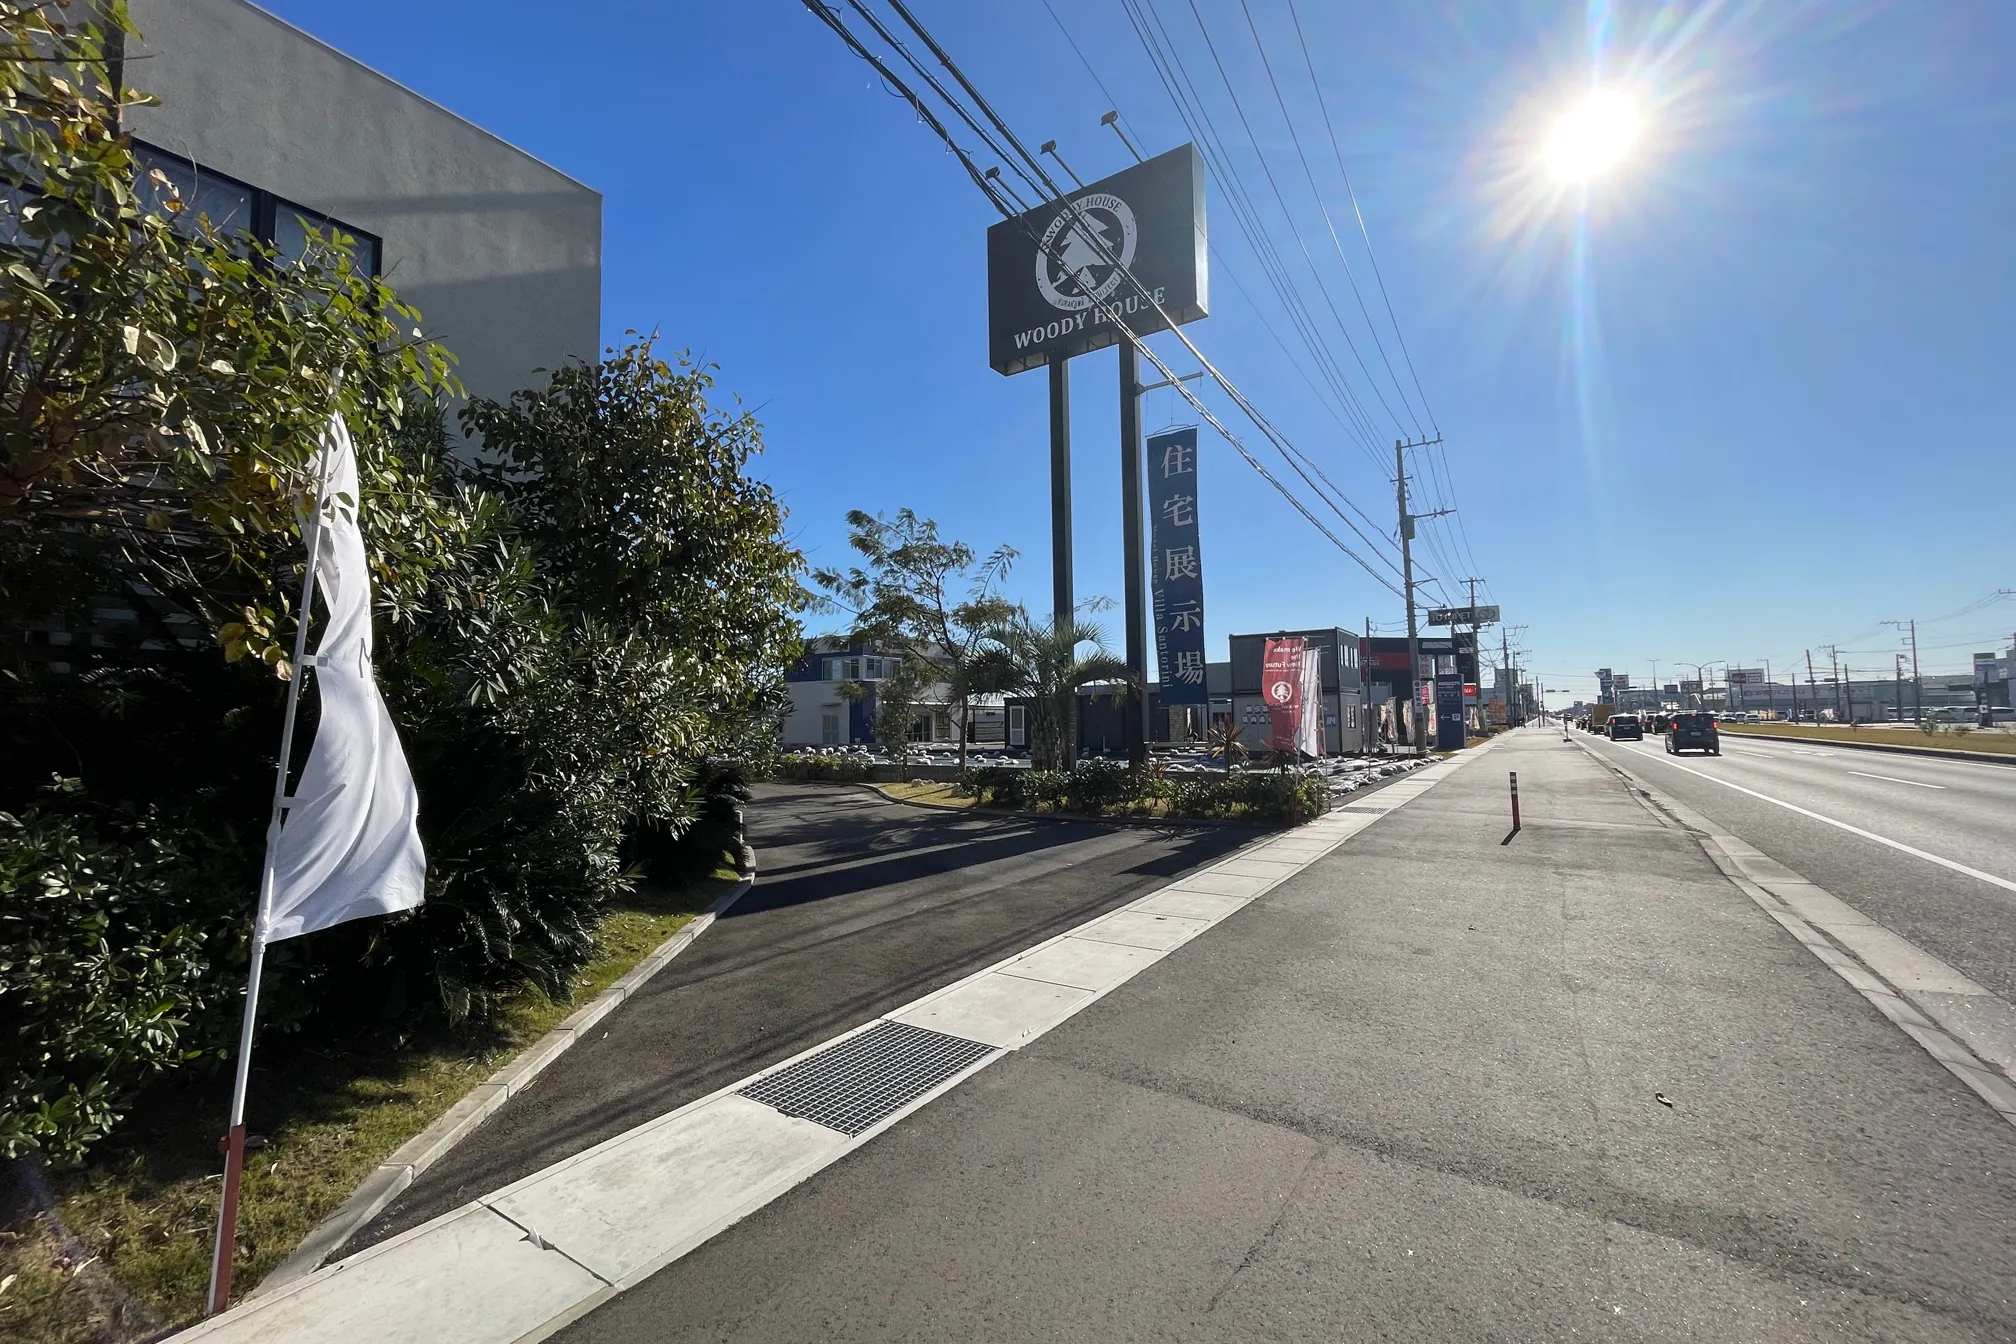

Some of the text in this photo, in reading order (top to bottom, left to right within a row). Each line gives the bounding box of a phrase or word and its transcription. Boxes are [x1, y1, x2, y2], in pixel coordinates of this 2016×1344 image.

[1086, 195, 1122, 213] HOUSE
[1013, 311, 1087, 350] WOODY
[1161, 444, 1204, 685] 住宅展示場
[1154, 588, 1165, 620] Villa
[1157, 626, 1173, 688] Santorini
